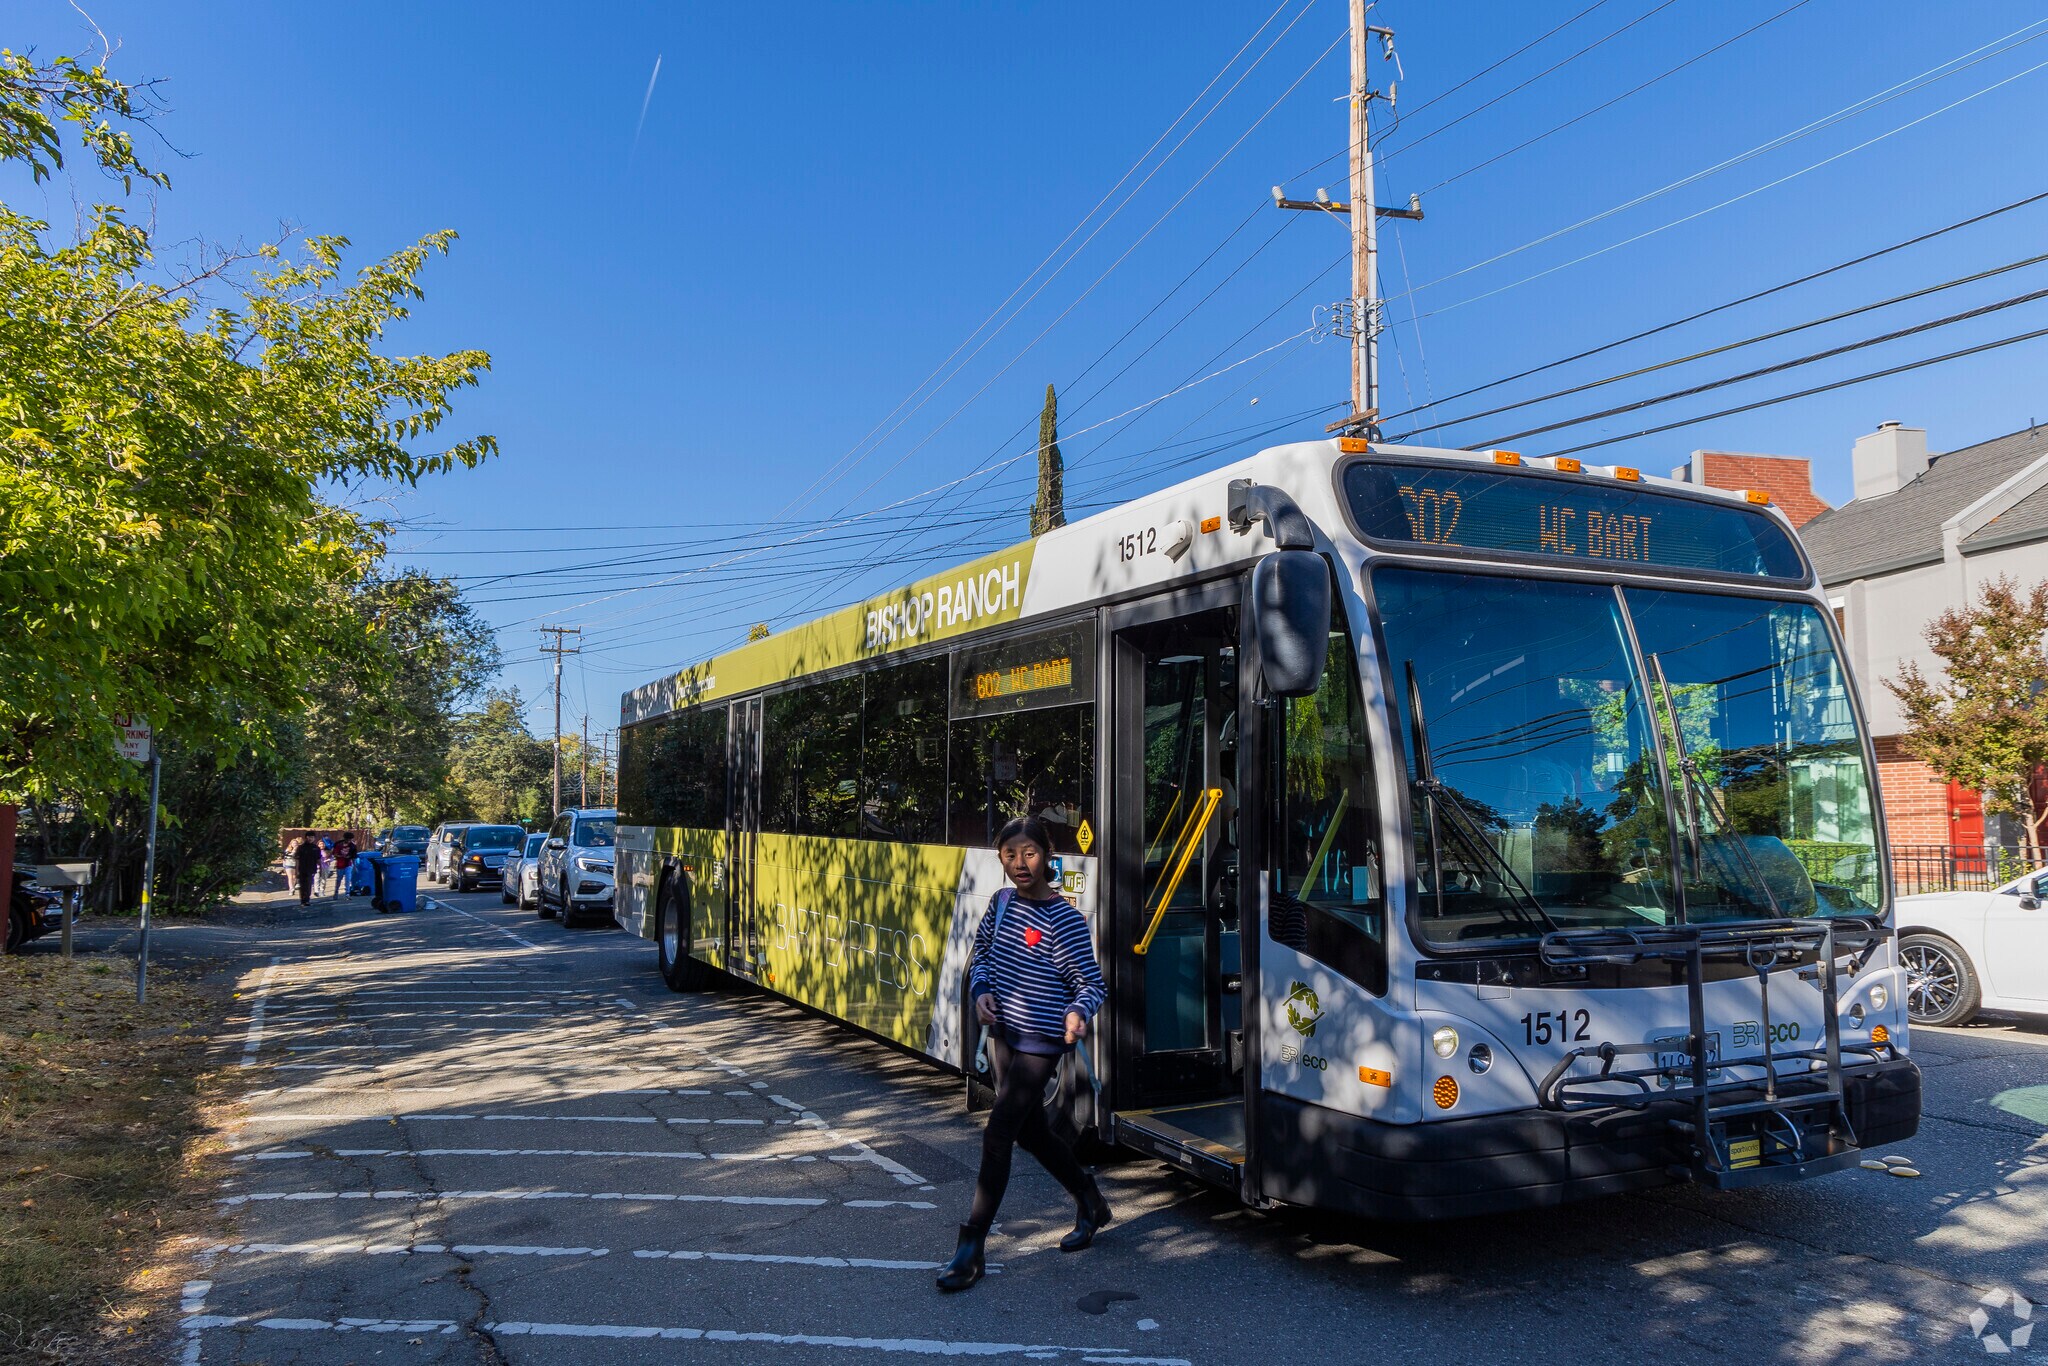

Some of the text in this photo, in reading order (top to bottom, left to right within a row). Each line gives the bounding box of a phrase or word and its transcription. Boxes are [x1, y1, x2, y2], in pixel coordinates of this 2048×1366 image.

[1118, 527, 1157, 563] 1512
[1539, 505, 1577, 555] WC
[1588, 511, 1652, 561] BART
[866, 561, 1020, 649] BISHOP RANCH
[977, 657, 1069, 699] 602 WC BART
[116, 730, 149, 740] RKING
[775, 903, 928, 996] BART EXPRESS
[1520, 1008, 1591, 1046] 1512
[1733, 1021, 1800, 1048] BR eco
[1281, 1044, 1328, 1071] BR eco
